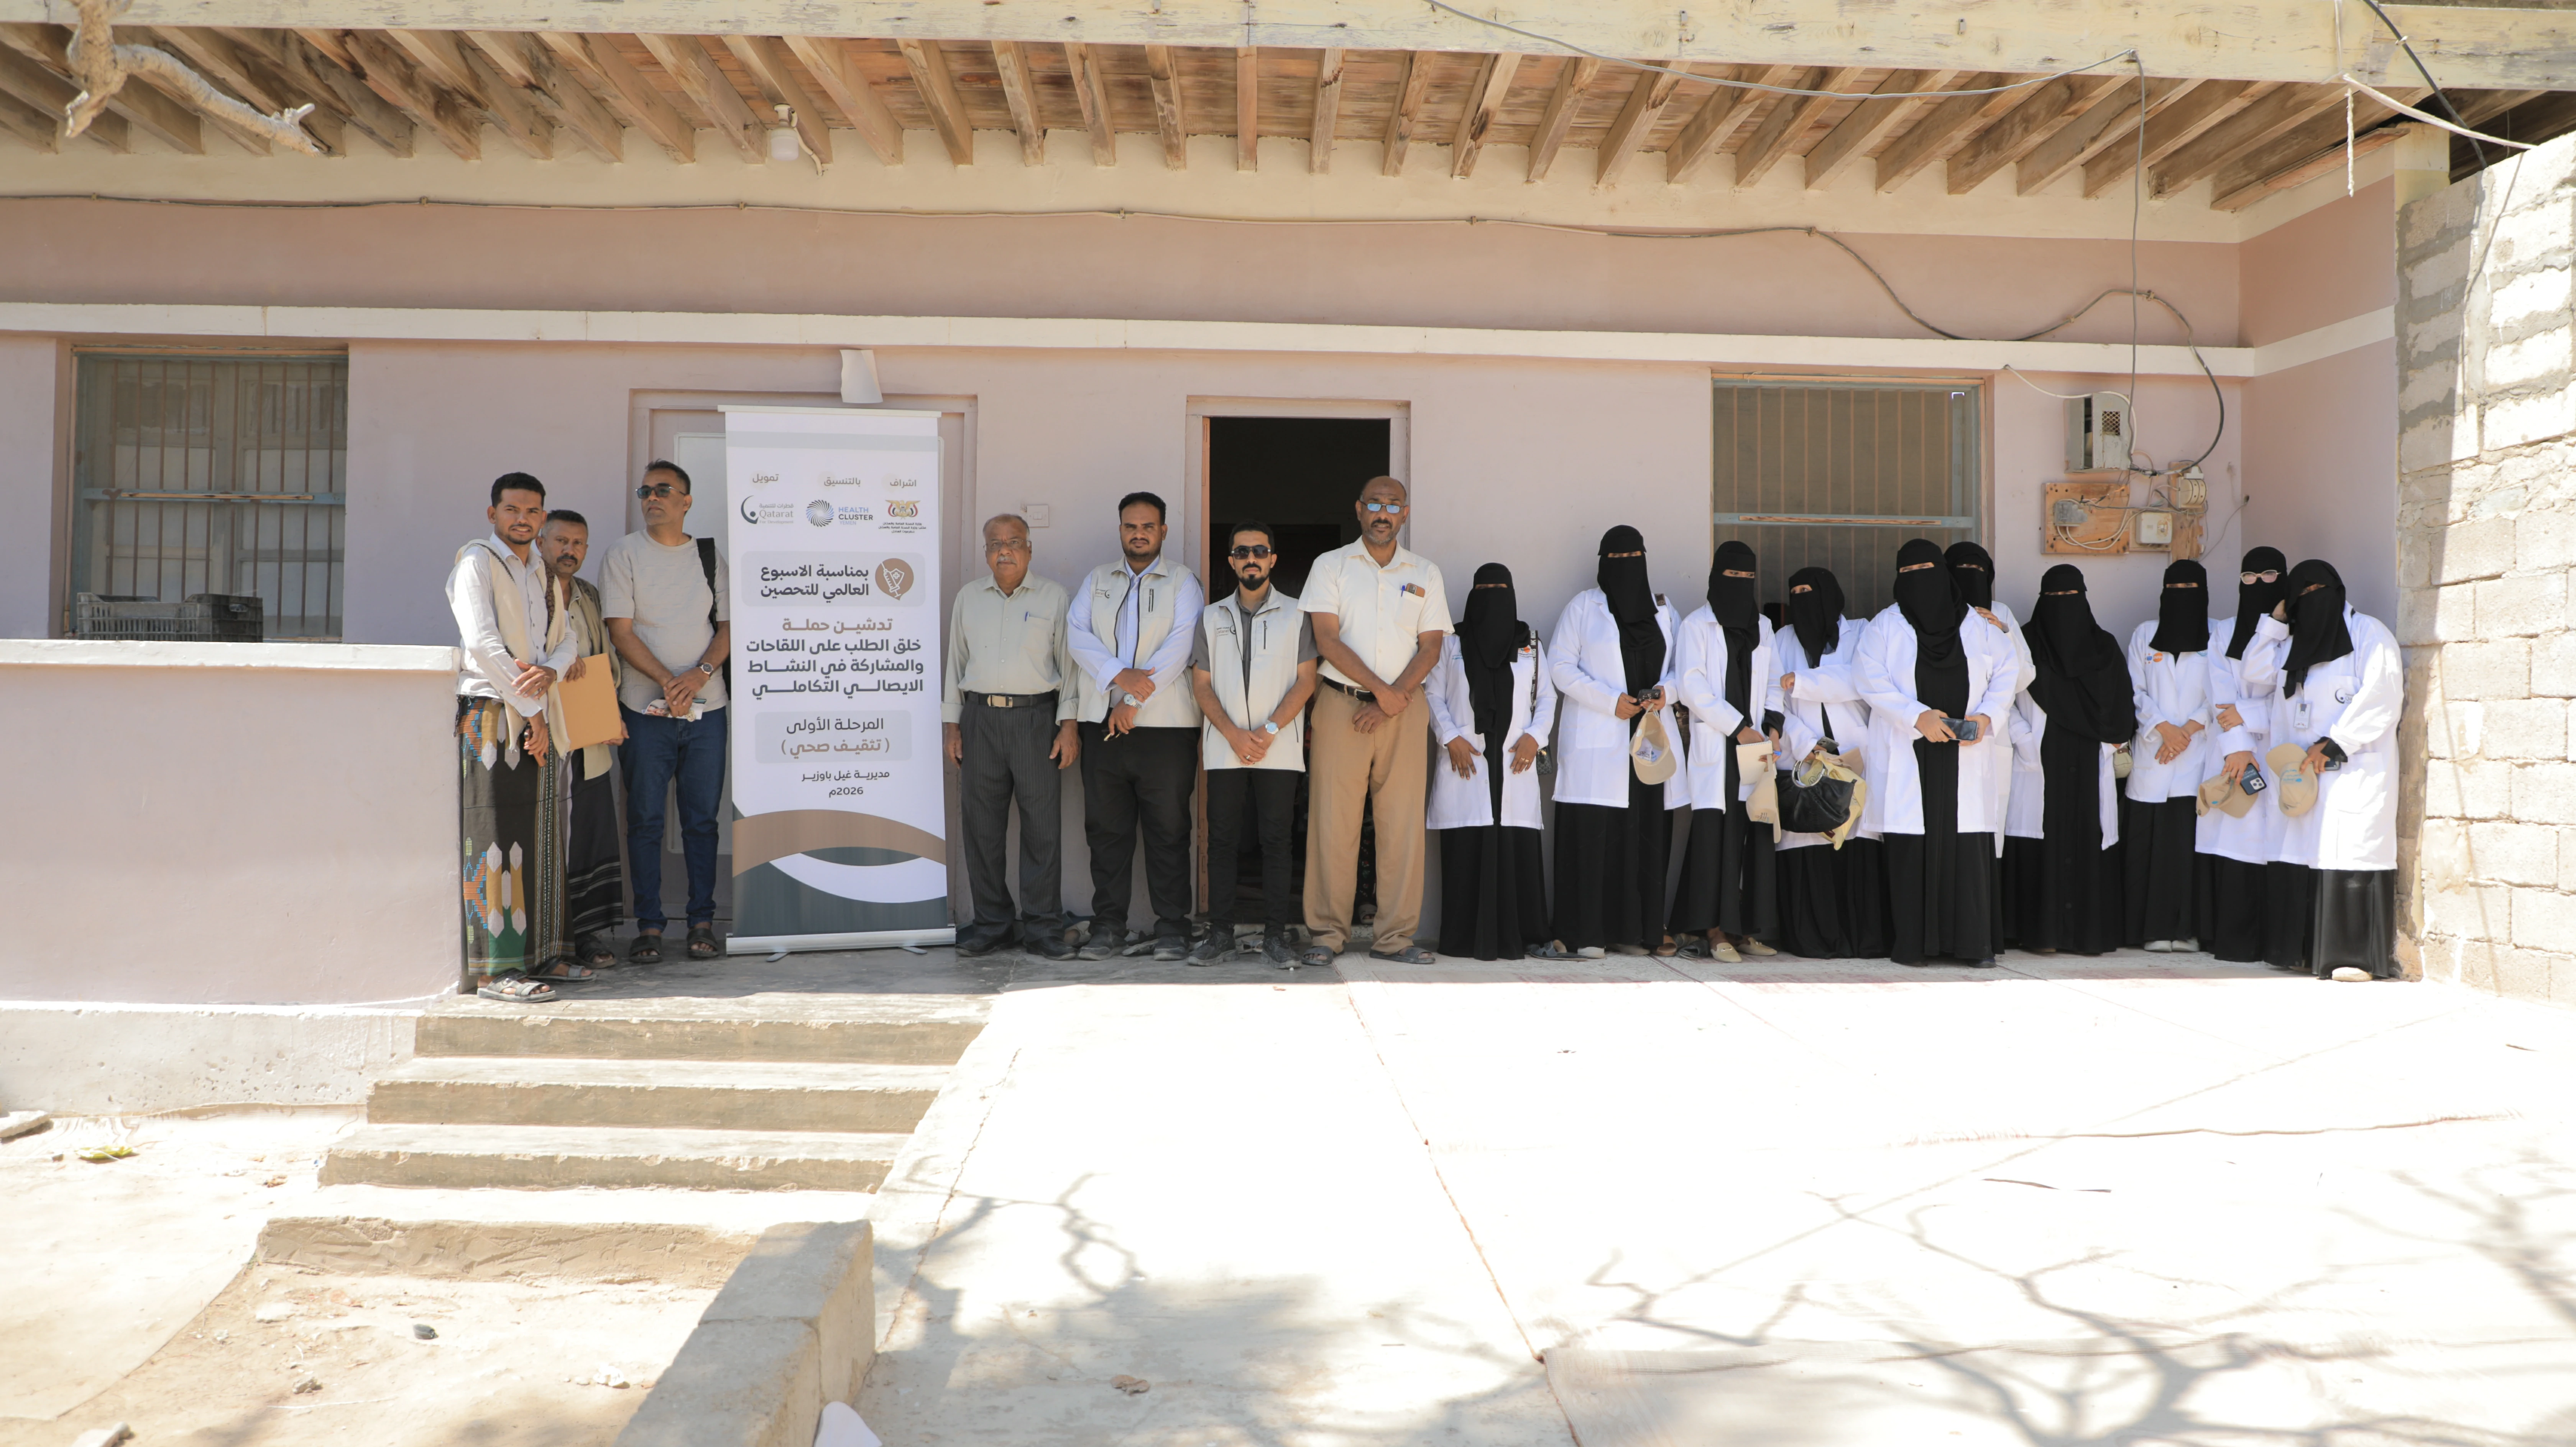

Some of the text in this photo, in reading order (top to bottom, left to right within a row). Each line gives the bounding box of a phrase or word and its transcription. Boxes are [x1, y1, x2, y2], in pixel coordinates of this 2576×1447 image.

[752, 474, 779, 483] تمويل
[824, 477, 861, 487] بالتنسيق
[890, 479, 916, 488] اشراف
[759, 510, 794, 518] Qatarat
[761, 565, 869, 581] بمناسبة الاسبوع
[761, 583, 869, 603] العالمي للتحصين
[782, 618, 893, 634] تدشين حملة
[746, 638, 921, 655] خلق الطلب على اللقاحات
[748, 658, 924, 678] والمشاركة في النشاط
[752, 679, 923, 700] الايصالي التكاملي
[786, 717, 884, 734] المرحلة الأولى
[790, 743, 830, 759] صحي
[833, 739, 882, 755] تثقيف
[801, 770, 890, 782] مديرية غيل باوزير
[829, 787, 864, 798] 2026م
